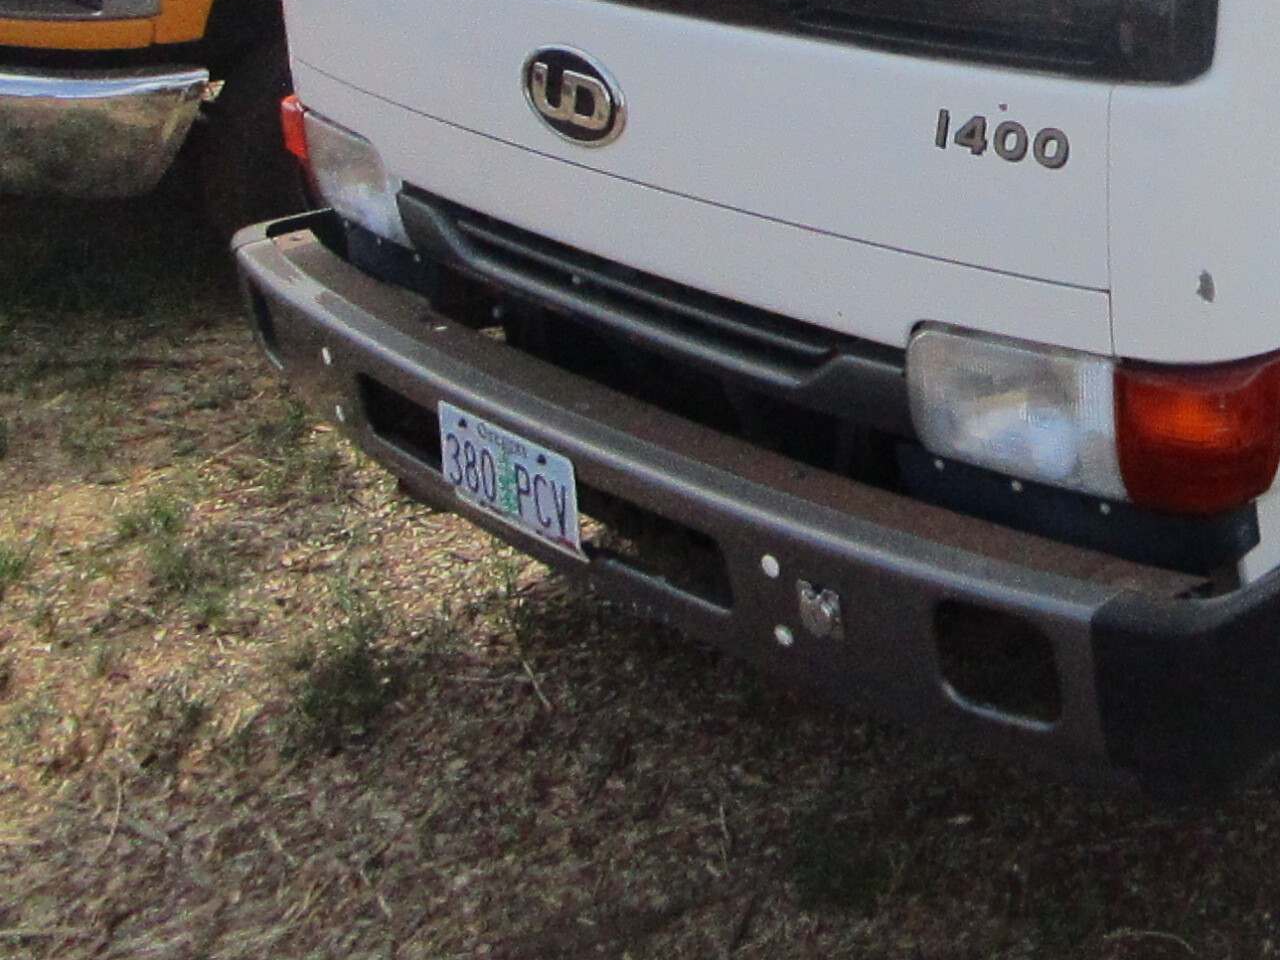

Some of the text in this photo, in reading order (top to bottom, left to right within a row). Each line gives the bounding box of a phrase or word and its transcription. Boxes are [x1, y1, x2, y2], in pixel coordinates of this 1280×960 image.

[935, 108, 1070, 170] 1400
[446, 432, 567, 538] 380 PCV
